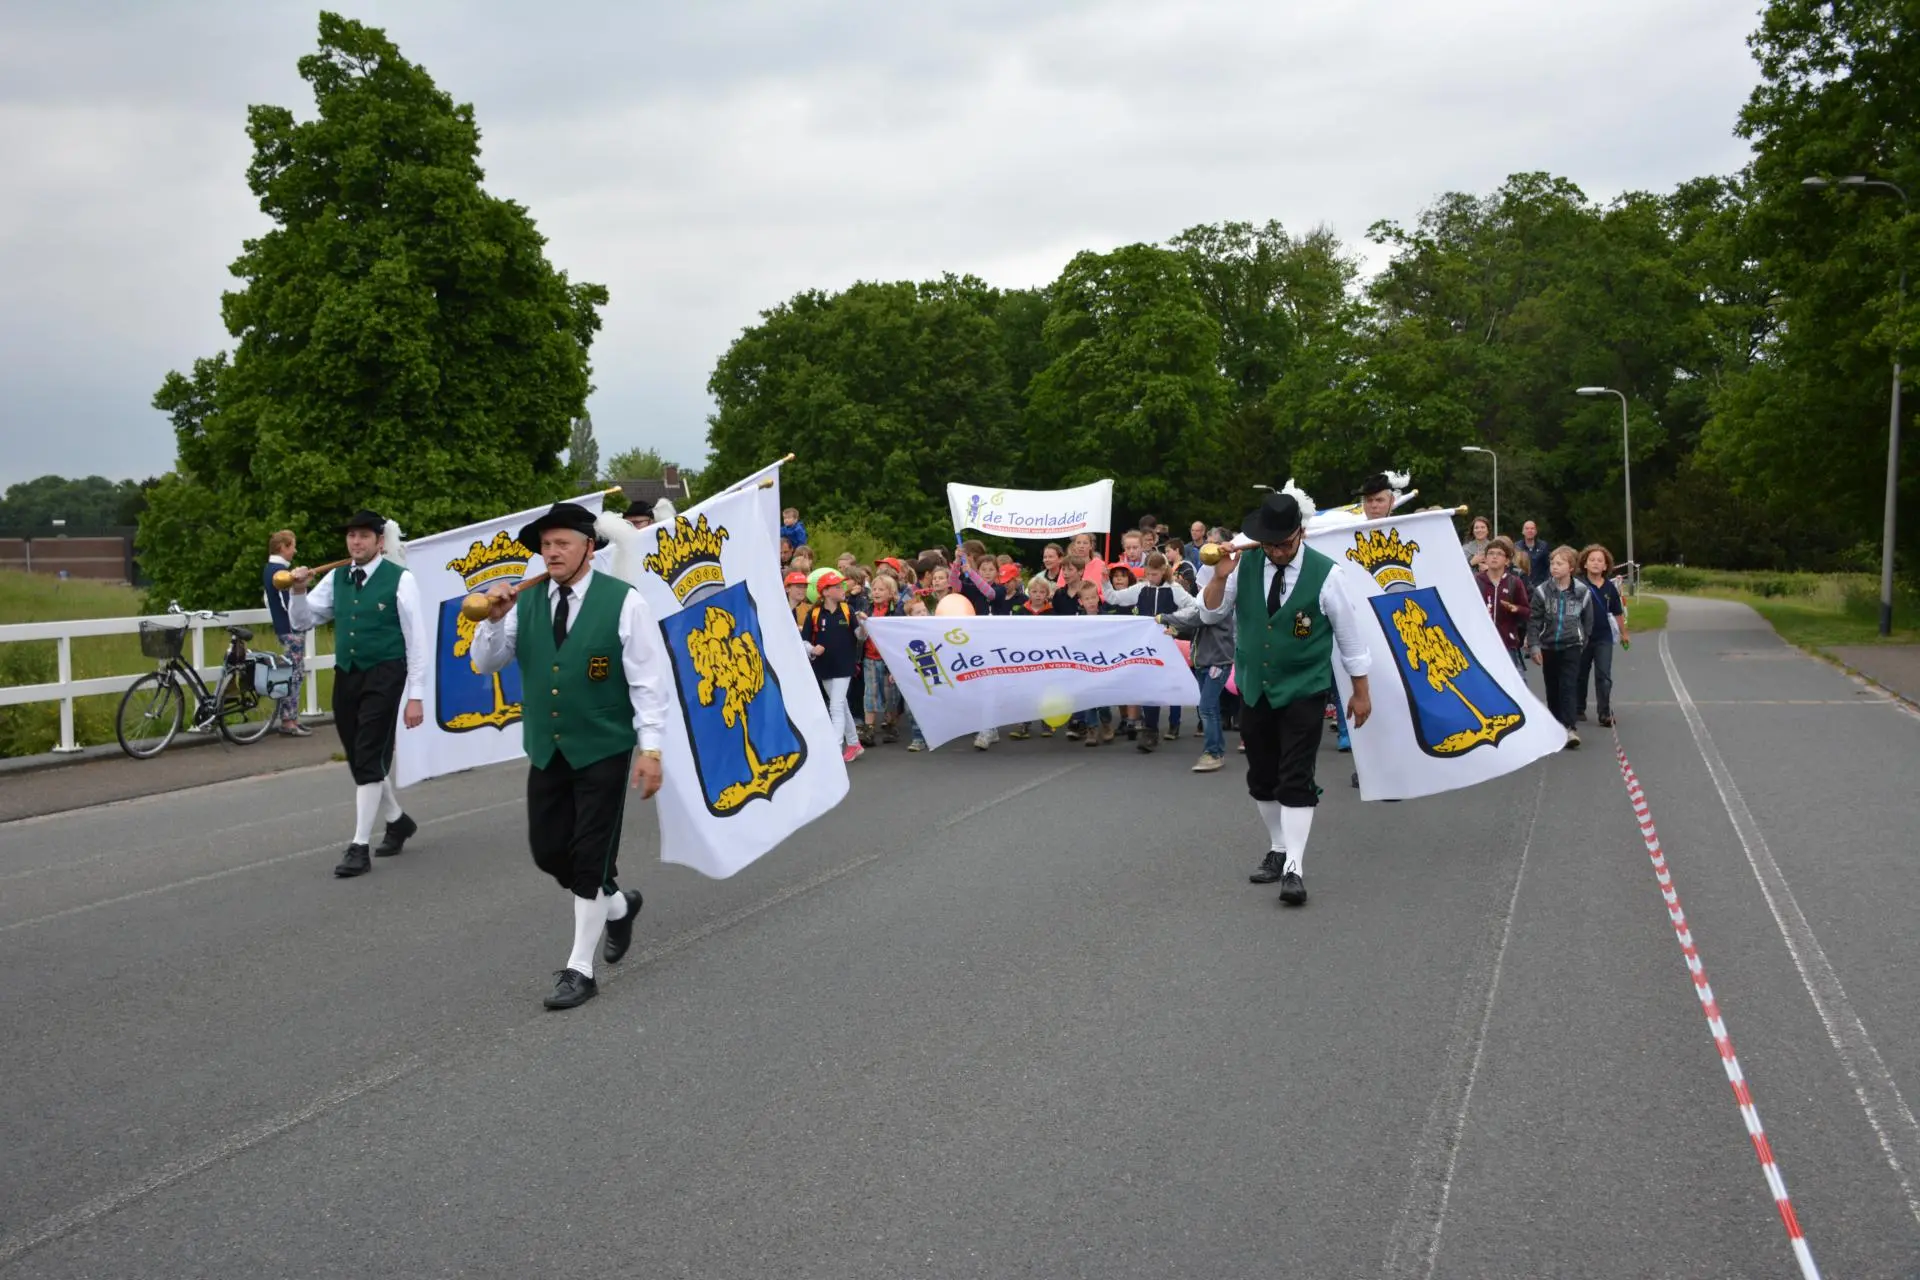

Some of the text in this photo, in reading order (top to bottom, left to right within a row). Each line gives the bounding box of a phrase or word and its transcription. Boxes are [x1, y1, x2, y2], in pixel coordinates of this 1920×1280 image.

[983, 510, 1088, 527] de Toonladder
[950, 645, 1158, 672] de Toonladder
